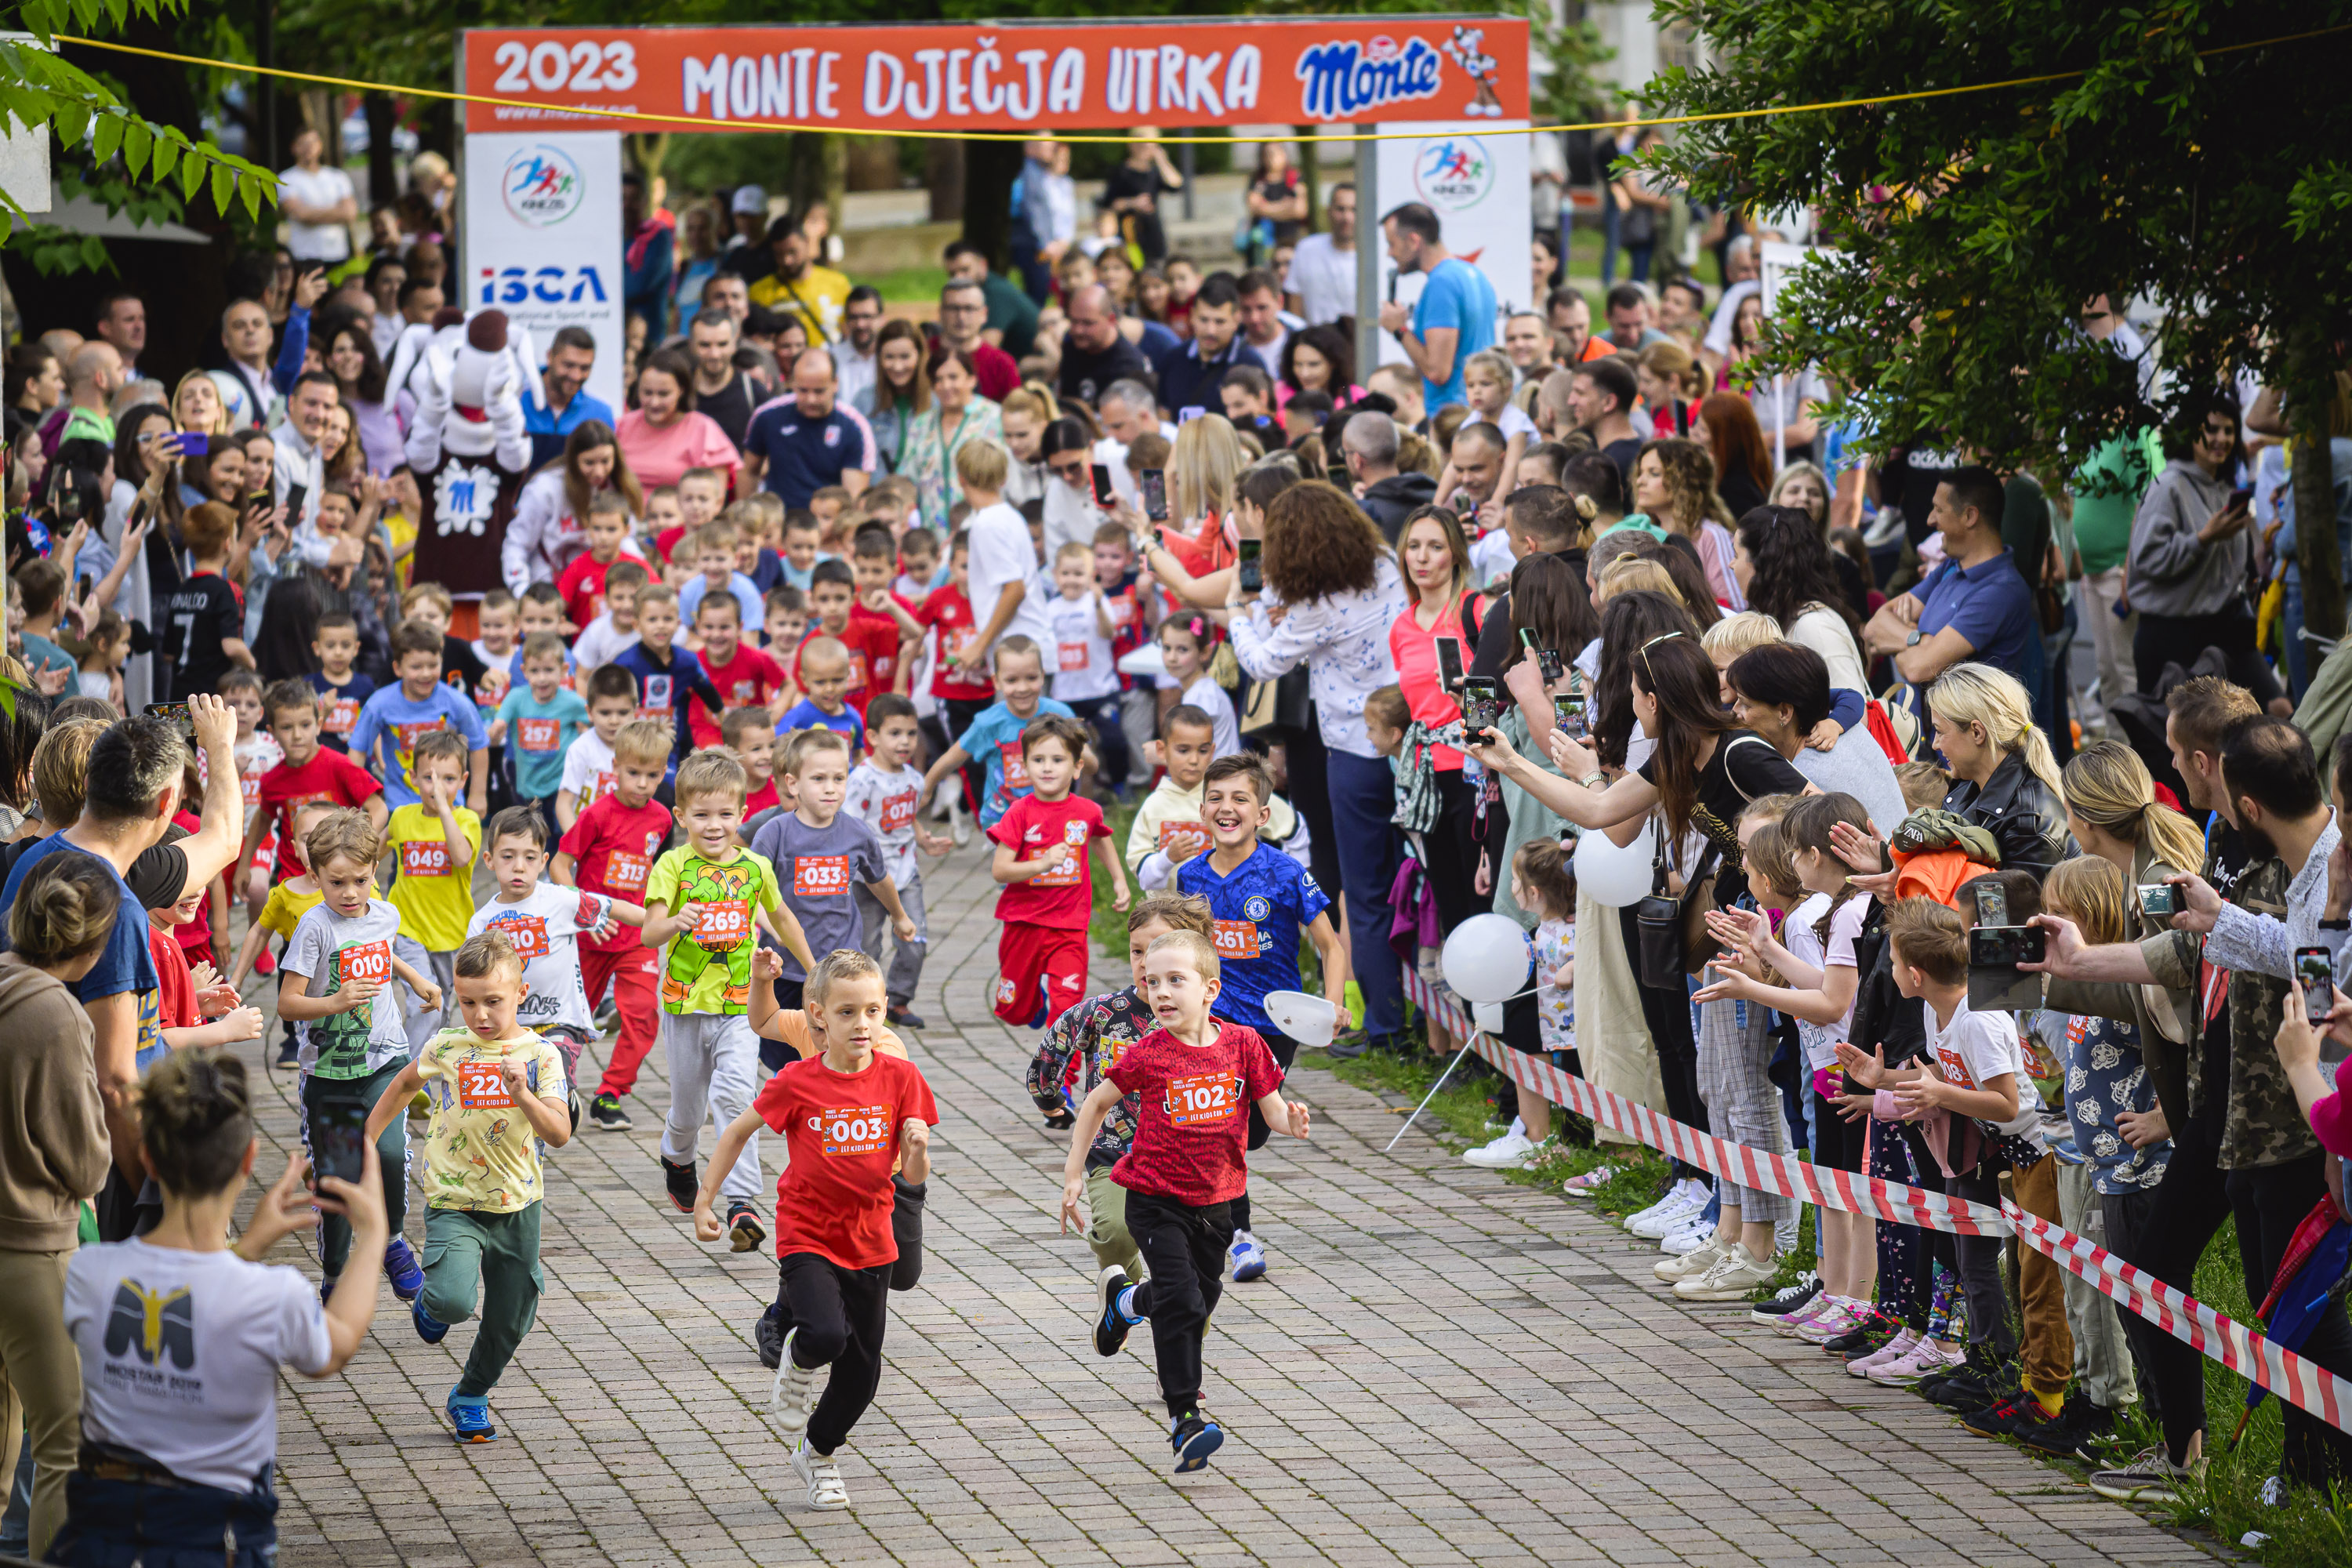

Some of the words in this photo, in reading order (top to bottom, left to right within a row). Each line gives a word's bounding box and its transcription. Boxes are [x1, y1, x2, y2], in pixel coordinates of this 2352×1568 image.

[494, 40, 638, 92] 2023
[1296, 36, 1441, 119] Monte
[682, 47, 841, 120] MONTE
[862, 36, 1086, 121] DJEČJA
[1106, 44, 1262, 117] UTRKA
[174, 613, 195, 666] 7
[1904, 826, 1923, 843] ZARA
[409, 849, 445, 868] 049
[617, 862, 646, 882] 313
[804, 866, 841, 885] 033
[702, 910, 741, 931] 269
[507, 929, 535, 949] 10
[1214, 930, 1245, 949] 261
[351, 953, 384, 978] 010
[1182, 1085, 1226, 1111] 102
[832, 1117, 882, 1142] 003
